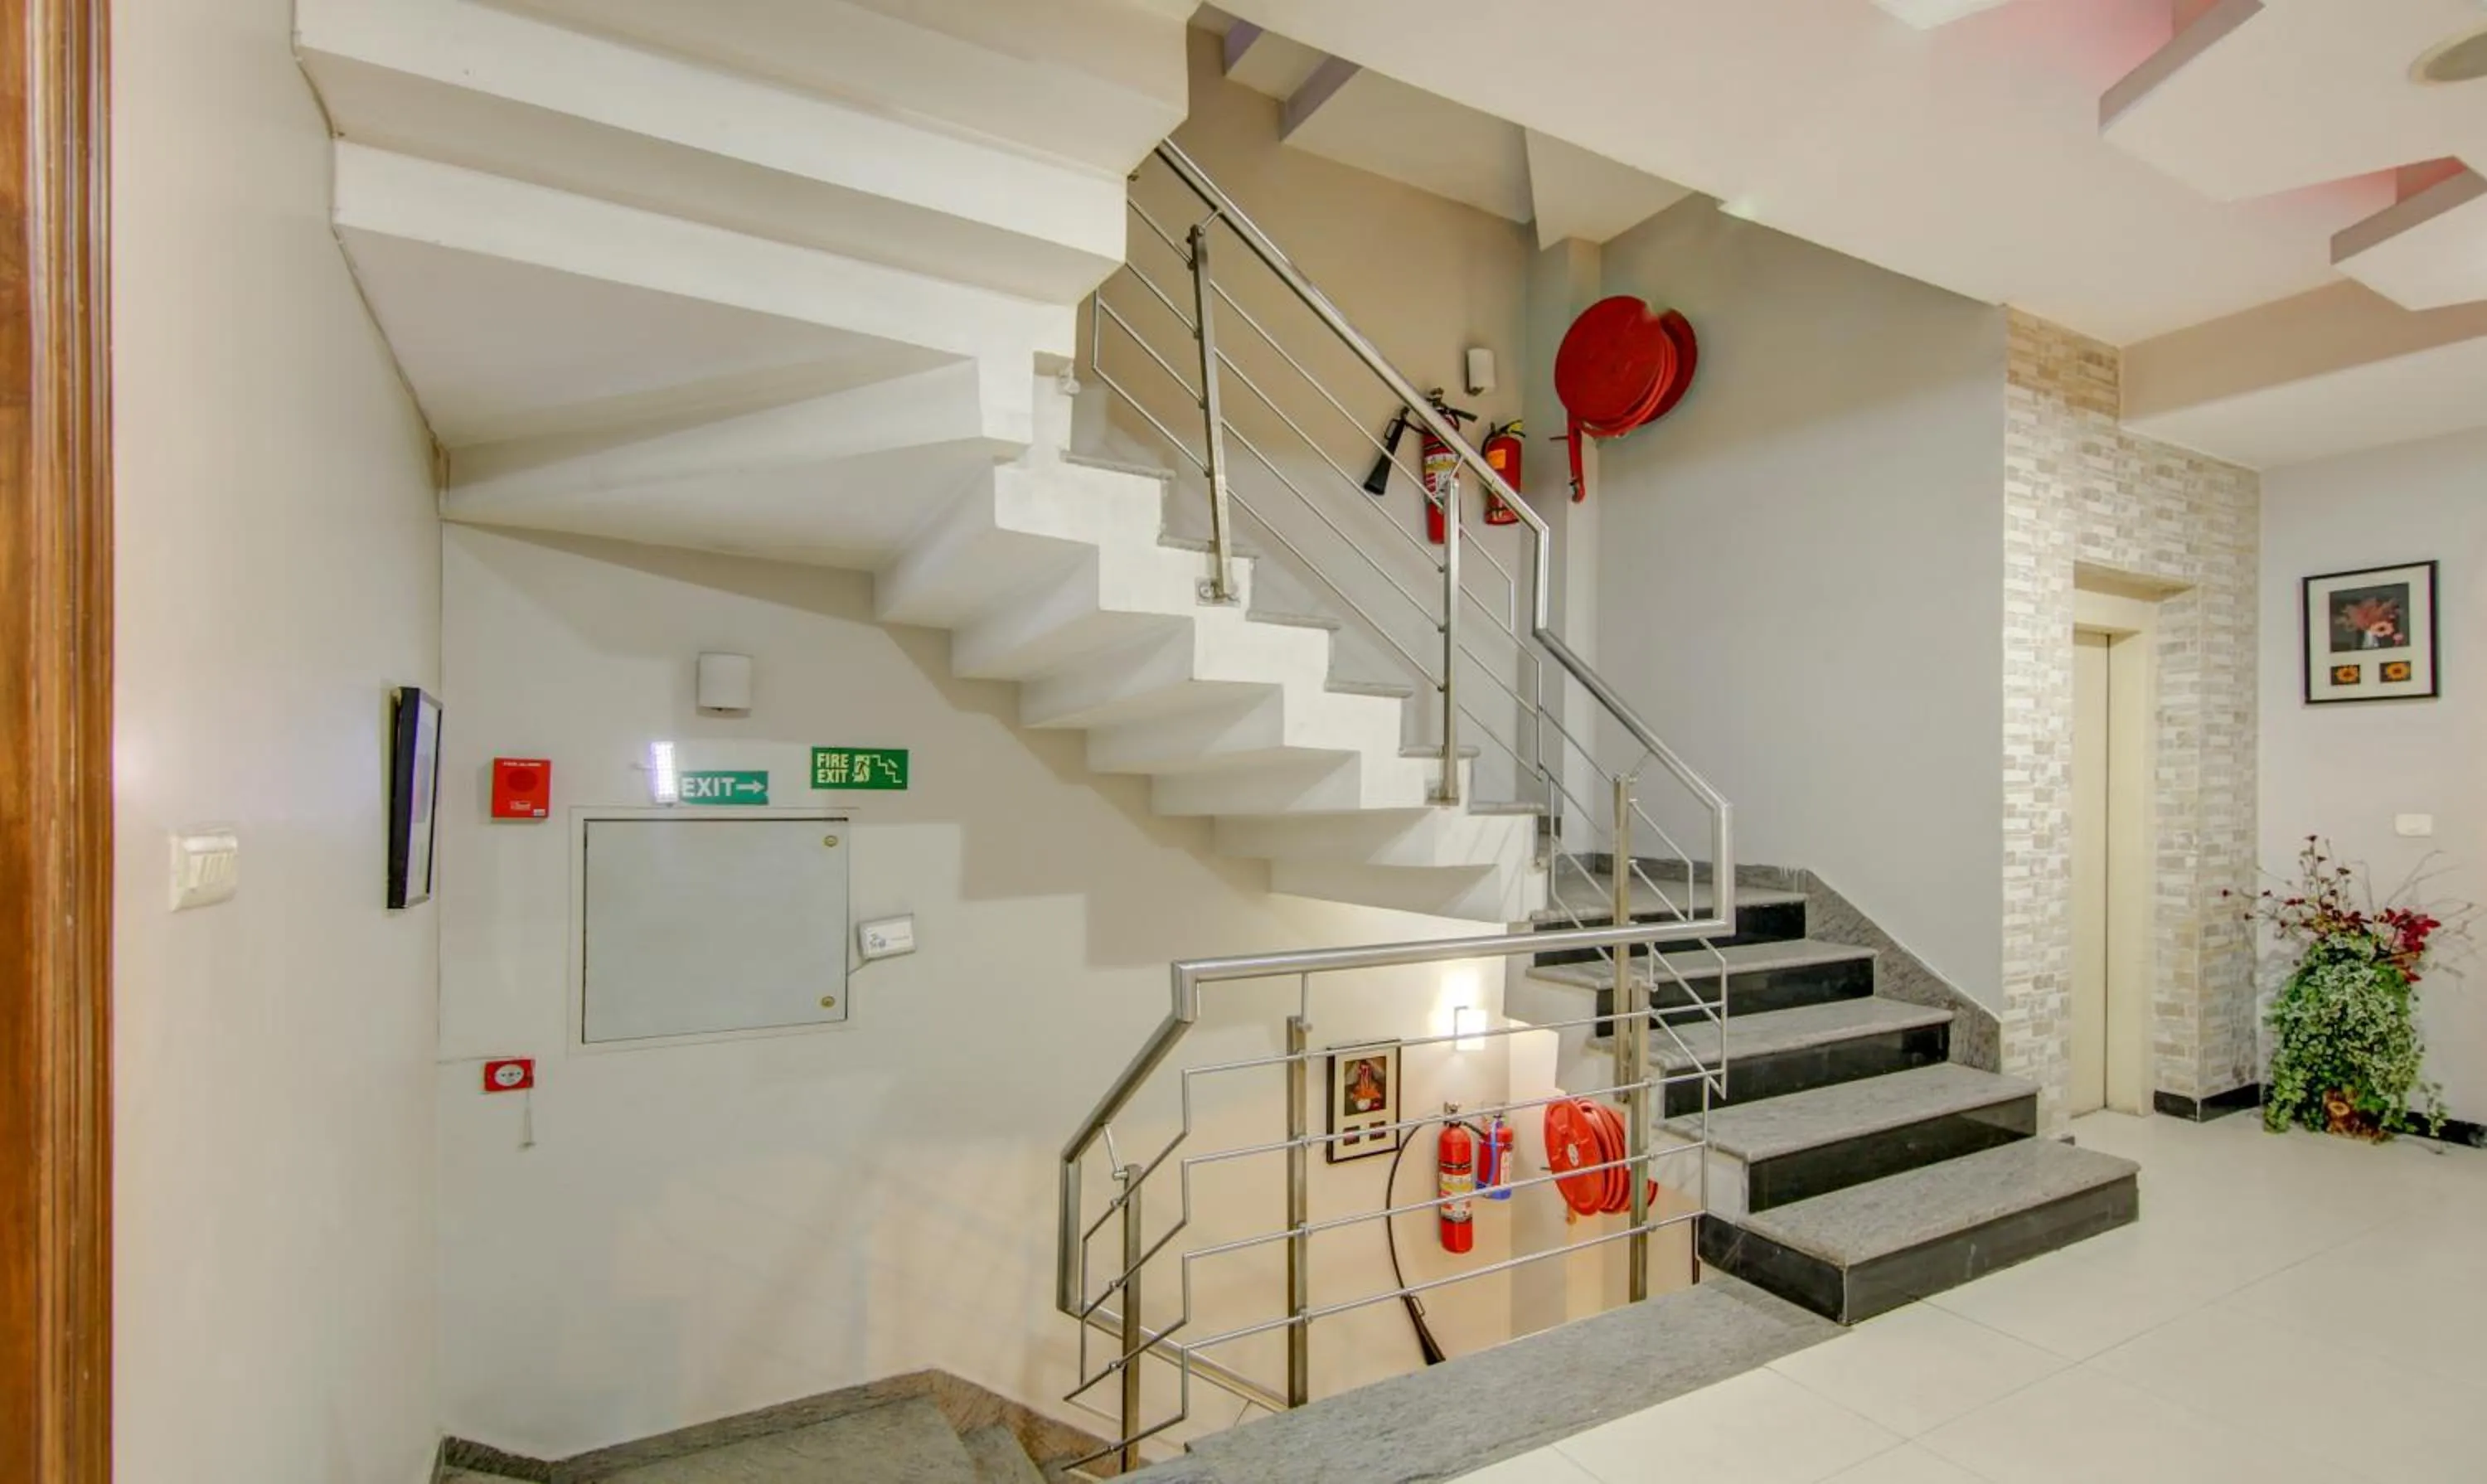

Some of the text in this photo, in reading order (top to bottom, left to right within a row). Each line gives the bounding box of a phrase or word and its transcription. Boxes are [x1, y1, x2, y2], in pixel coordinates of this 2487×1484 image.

[817, 753, 849, 769] FIRE
[817, 769, 848, 783] EXIT
[681, 777, 736, 797] EXIT
